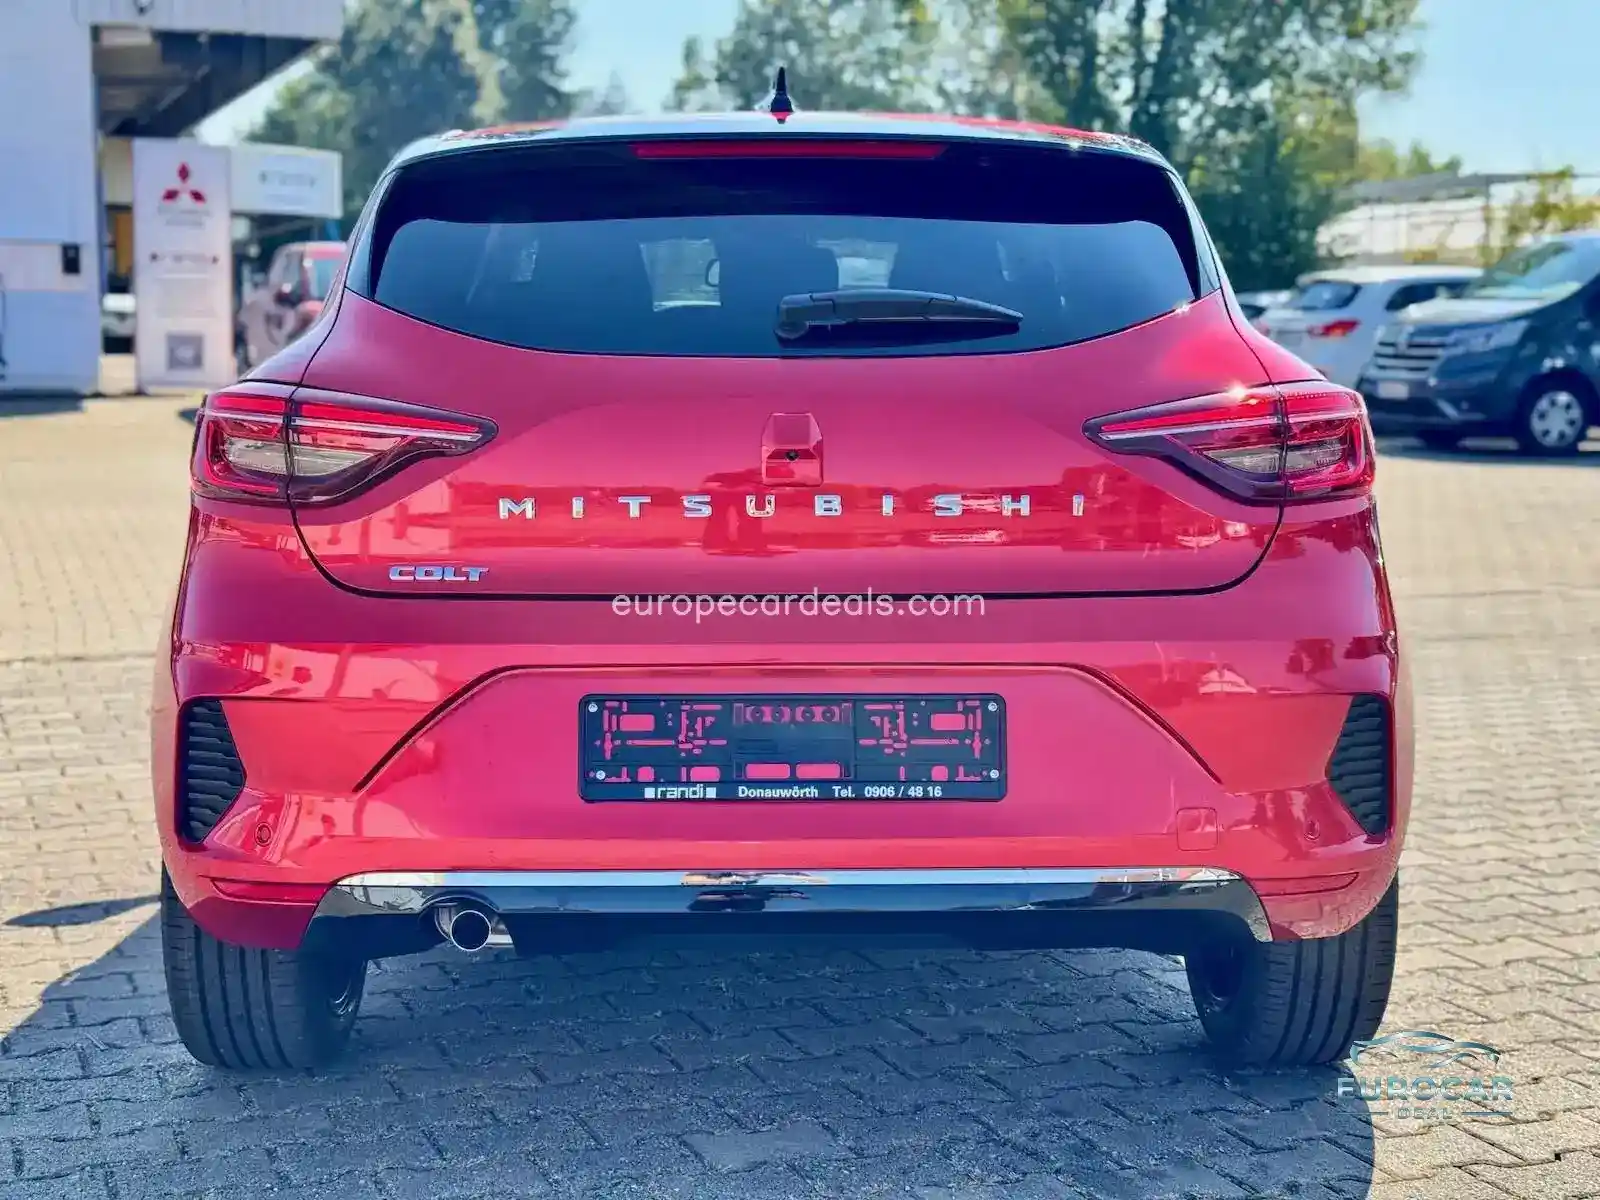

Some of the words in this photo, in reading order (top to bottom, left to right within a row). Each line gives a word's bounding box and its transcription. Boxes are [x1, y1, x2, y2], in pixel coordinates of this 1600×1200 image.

[498, 494, 1086, 519] MITSUBISHI
[388, 565, 489, 583] COLT
[738, 784, 818, 798] Donauwörth
[832, 784, 856, 798] Tel.
[864, 784, 895, 798] 0906
[908, 784, 924, 798] 48
[928, 784, 942, 798] 16
